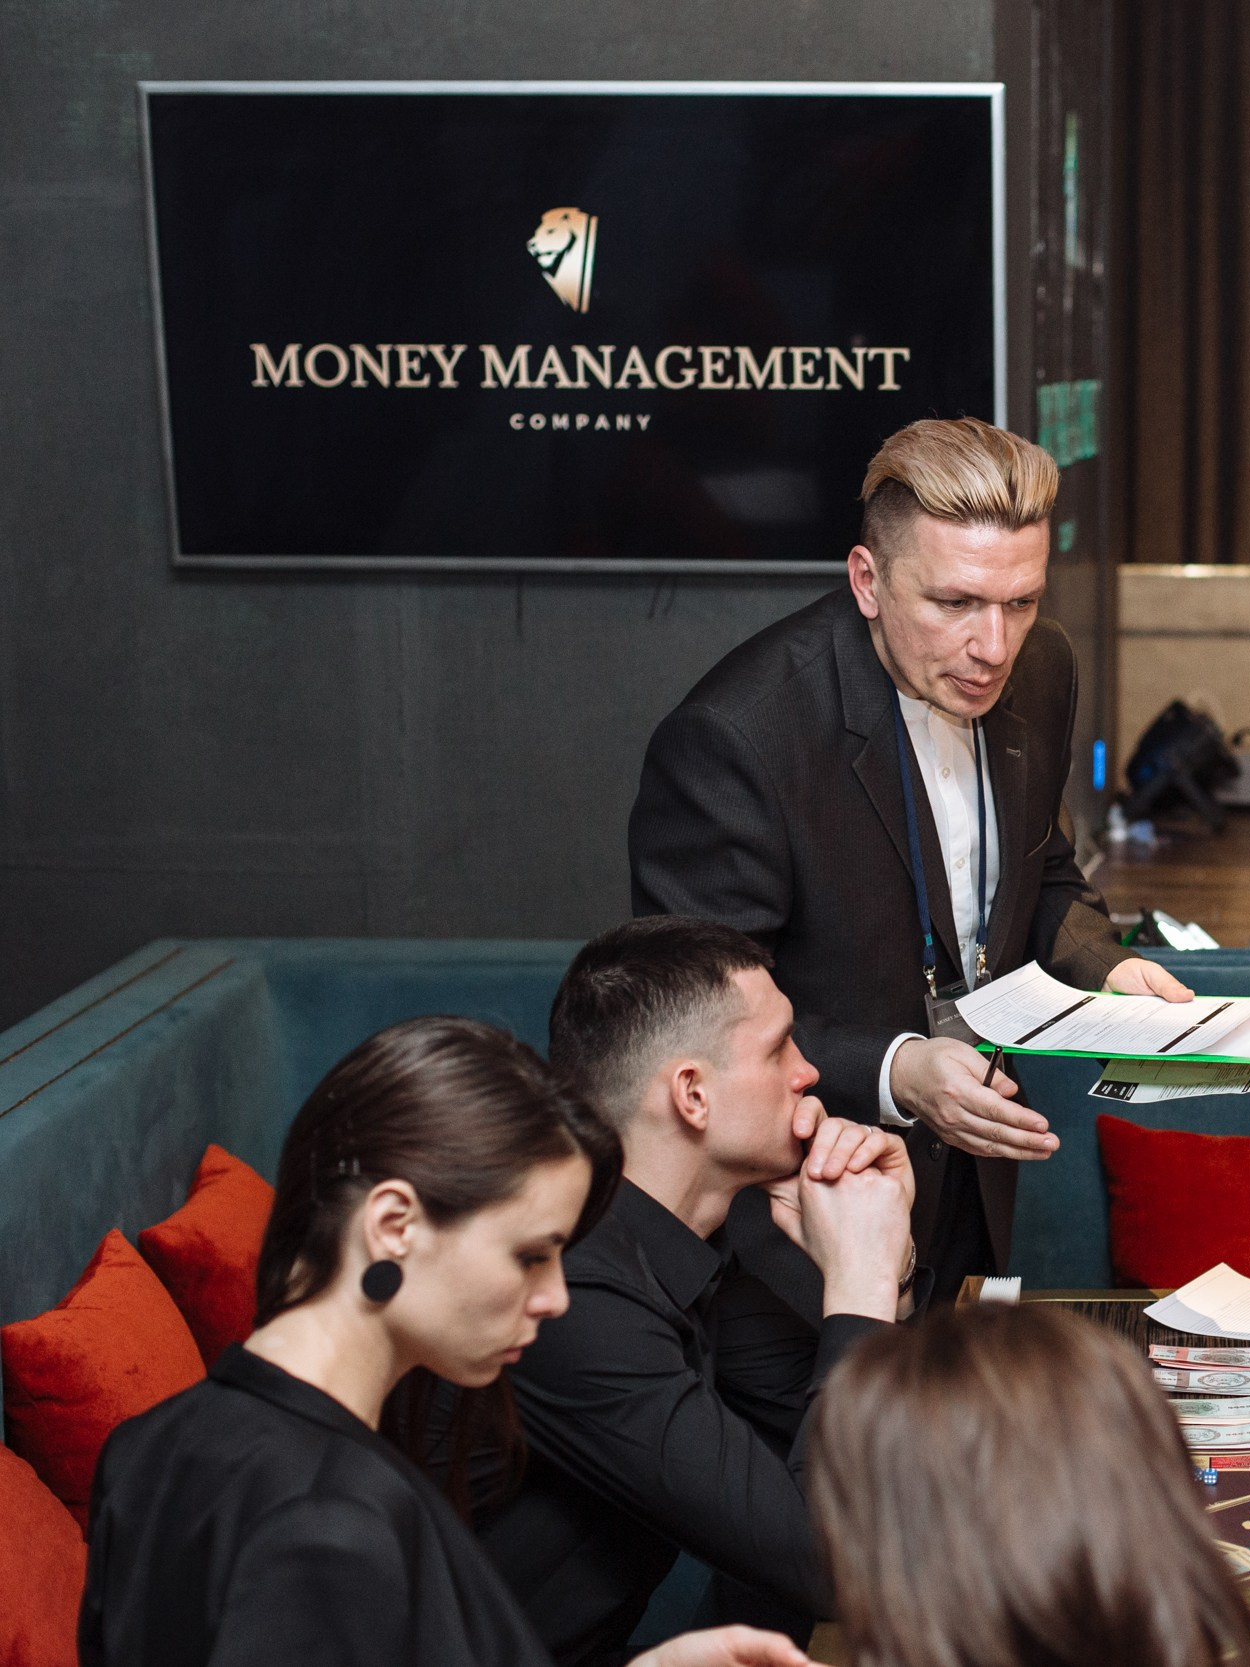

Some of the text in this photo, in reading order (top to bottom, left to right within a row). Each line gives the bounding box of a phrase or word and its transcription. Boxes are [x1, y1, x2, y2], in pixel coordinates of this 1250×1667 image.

[250, 343, 911, 391] MONEY MANAGEMENT
[509, 412, 651, 431] COMPANY
